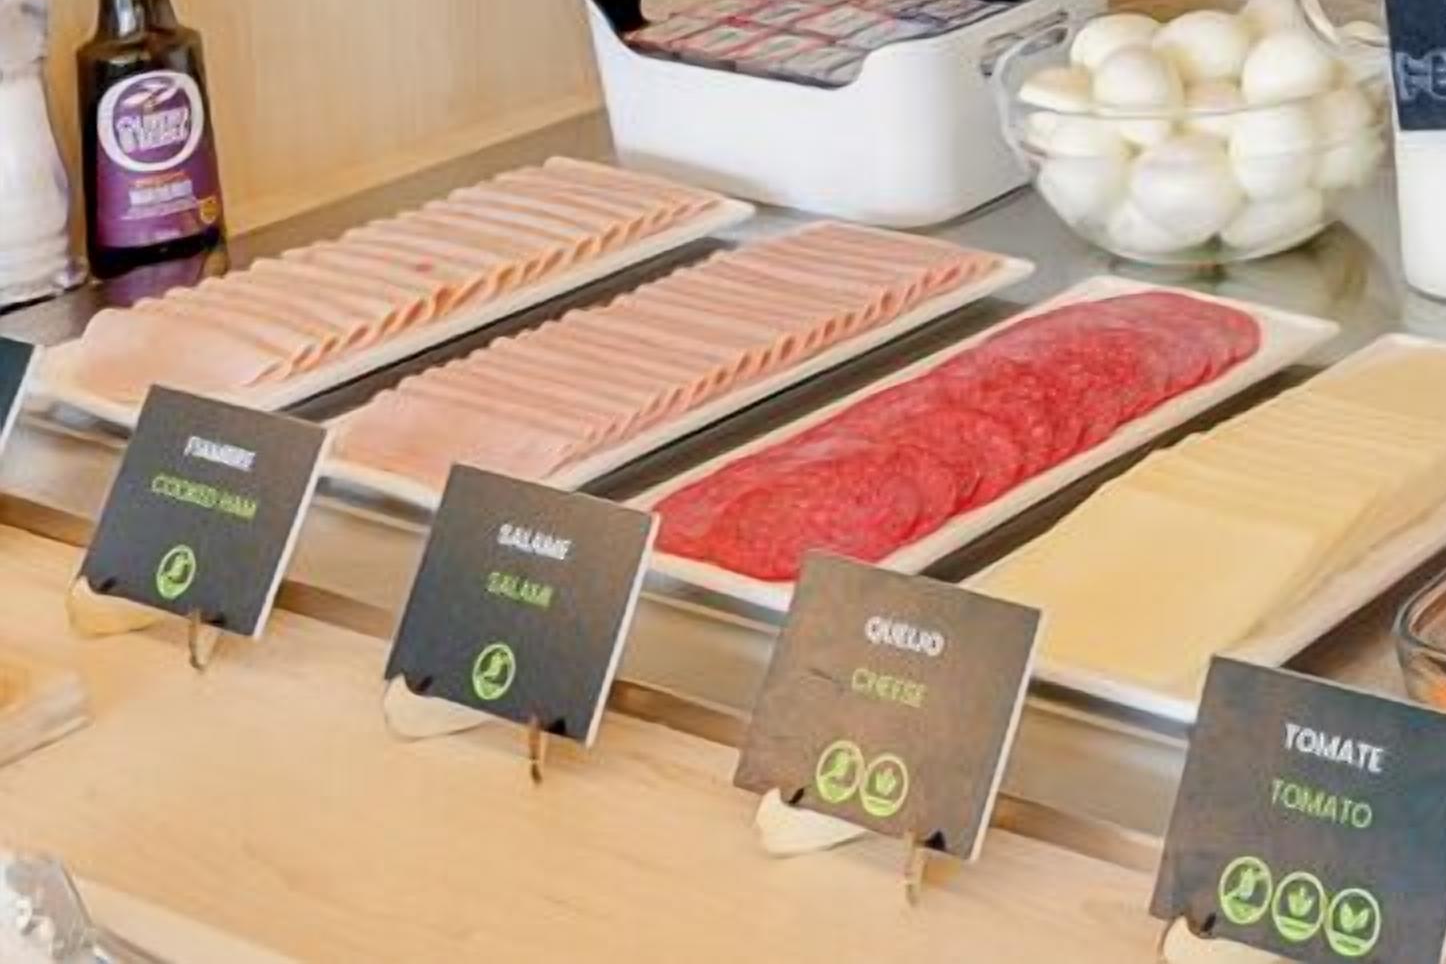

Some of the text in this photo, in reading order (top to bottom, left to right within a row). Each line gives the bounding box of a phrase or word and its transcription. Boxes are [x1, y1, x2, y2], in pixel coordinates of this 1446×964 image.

[497, 523, 572, 560] SALAME
[864, 616, 945, 657] QUEIJO
[1283, 722, 1385, 773] TOMATE
[1270, 779, 1373, 829] TOMATO
